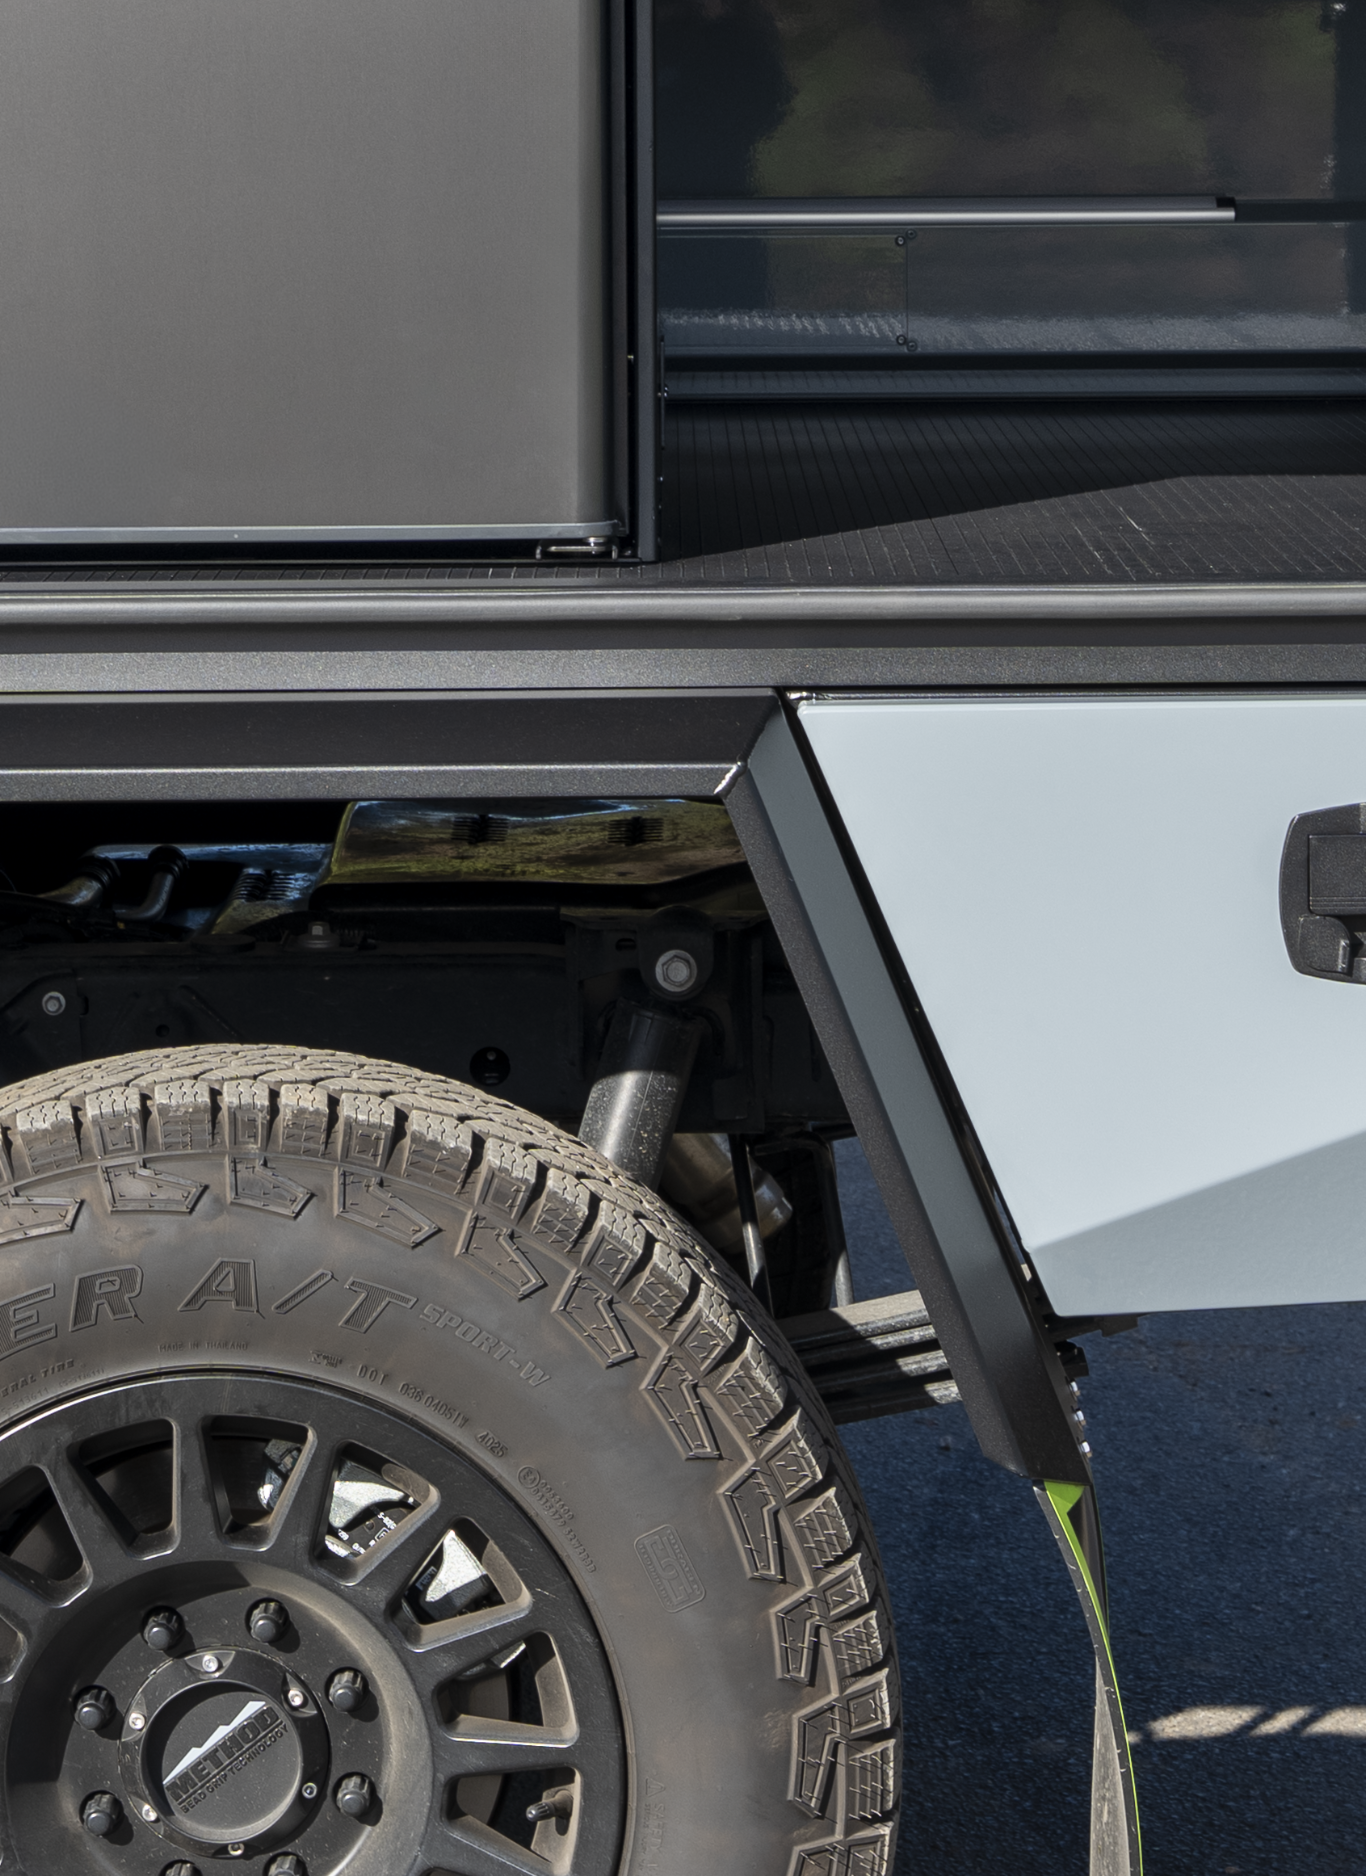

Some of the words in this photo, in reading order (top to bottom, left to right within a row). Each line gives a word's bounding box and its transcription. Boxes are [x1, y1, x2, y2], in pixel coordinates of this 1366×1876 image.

[39, 1357, 75, 1379] TIRE
[180, 1257, 418, 1333] A/T
[419, 1303, 551, 1387] SPORT-W
[356, 1363, 388, 1386] DOT
[477, 1429, 508, 1459] 4025
[164, 1705, 280, 1802] METHOD
[179, 1792, 207, 1814] BEAD
[207, 1774, 229, 1794] GRIP
[229, 1724, 289, 1776] TECHNOLOGY
